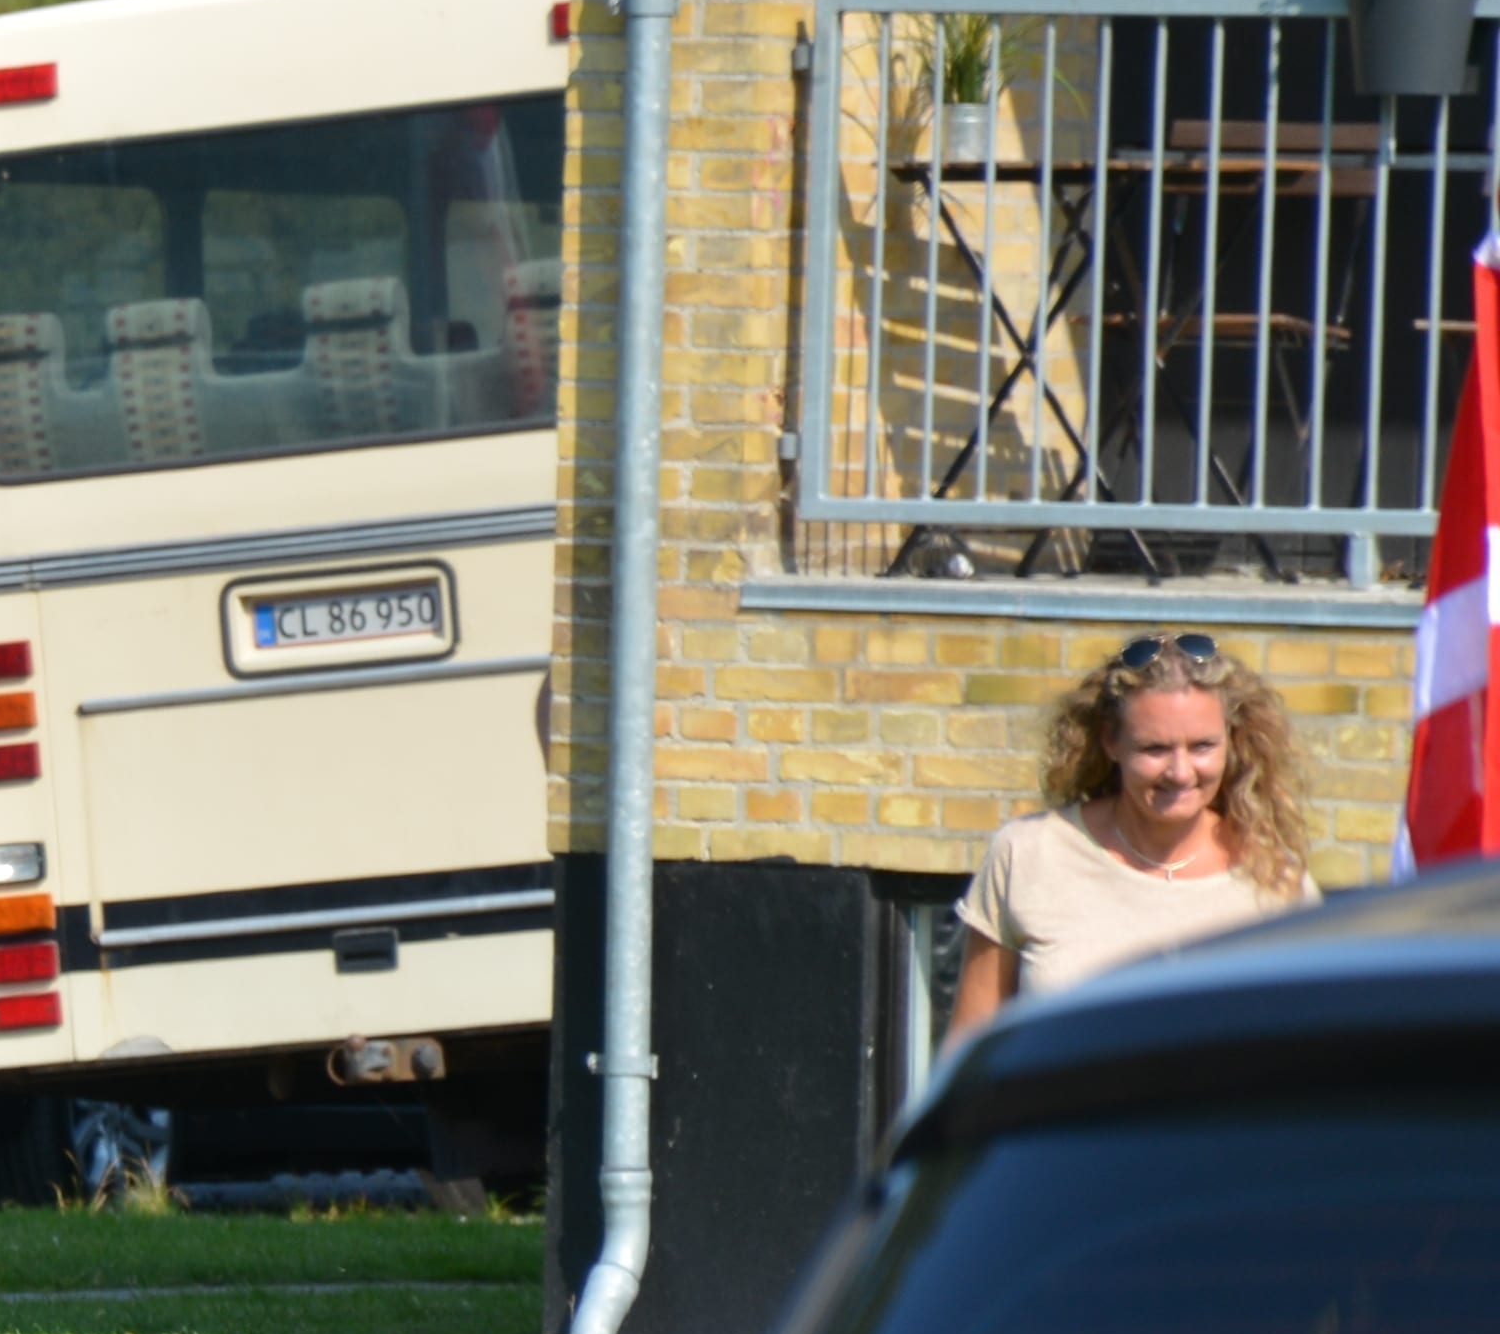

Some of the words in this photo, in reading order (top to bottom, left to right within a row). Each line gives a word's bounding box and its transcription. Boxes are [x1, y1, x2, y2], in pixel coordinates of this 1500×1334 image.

[277, 607, 318, 640] CL
[327, 599, 366, 634] 86
[375, 592, 437, 629] 950
